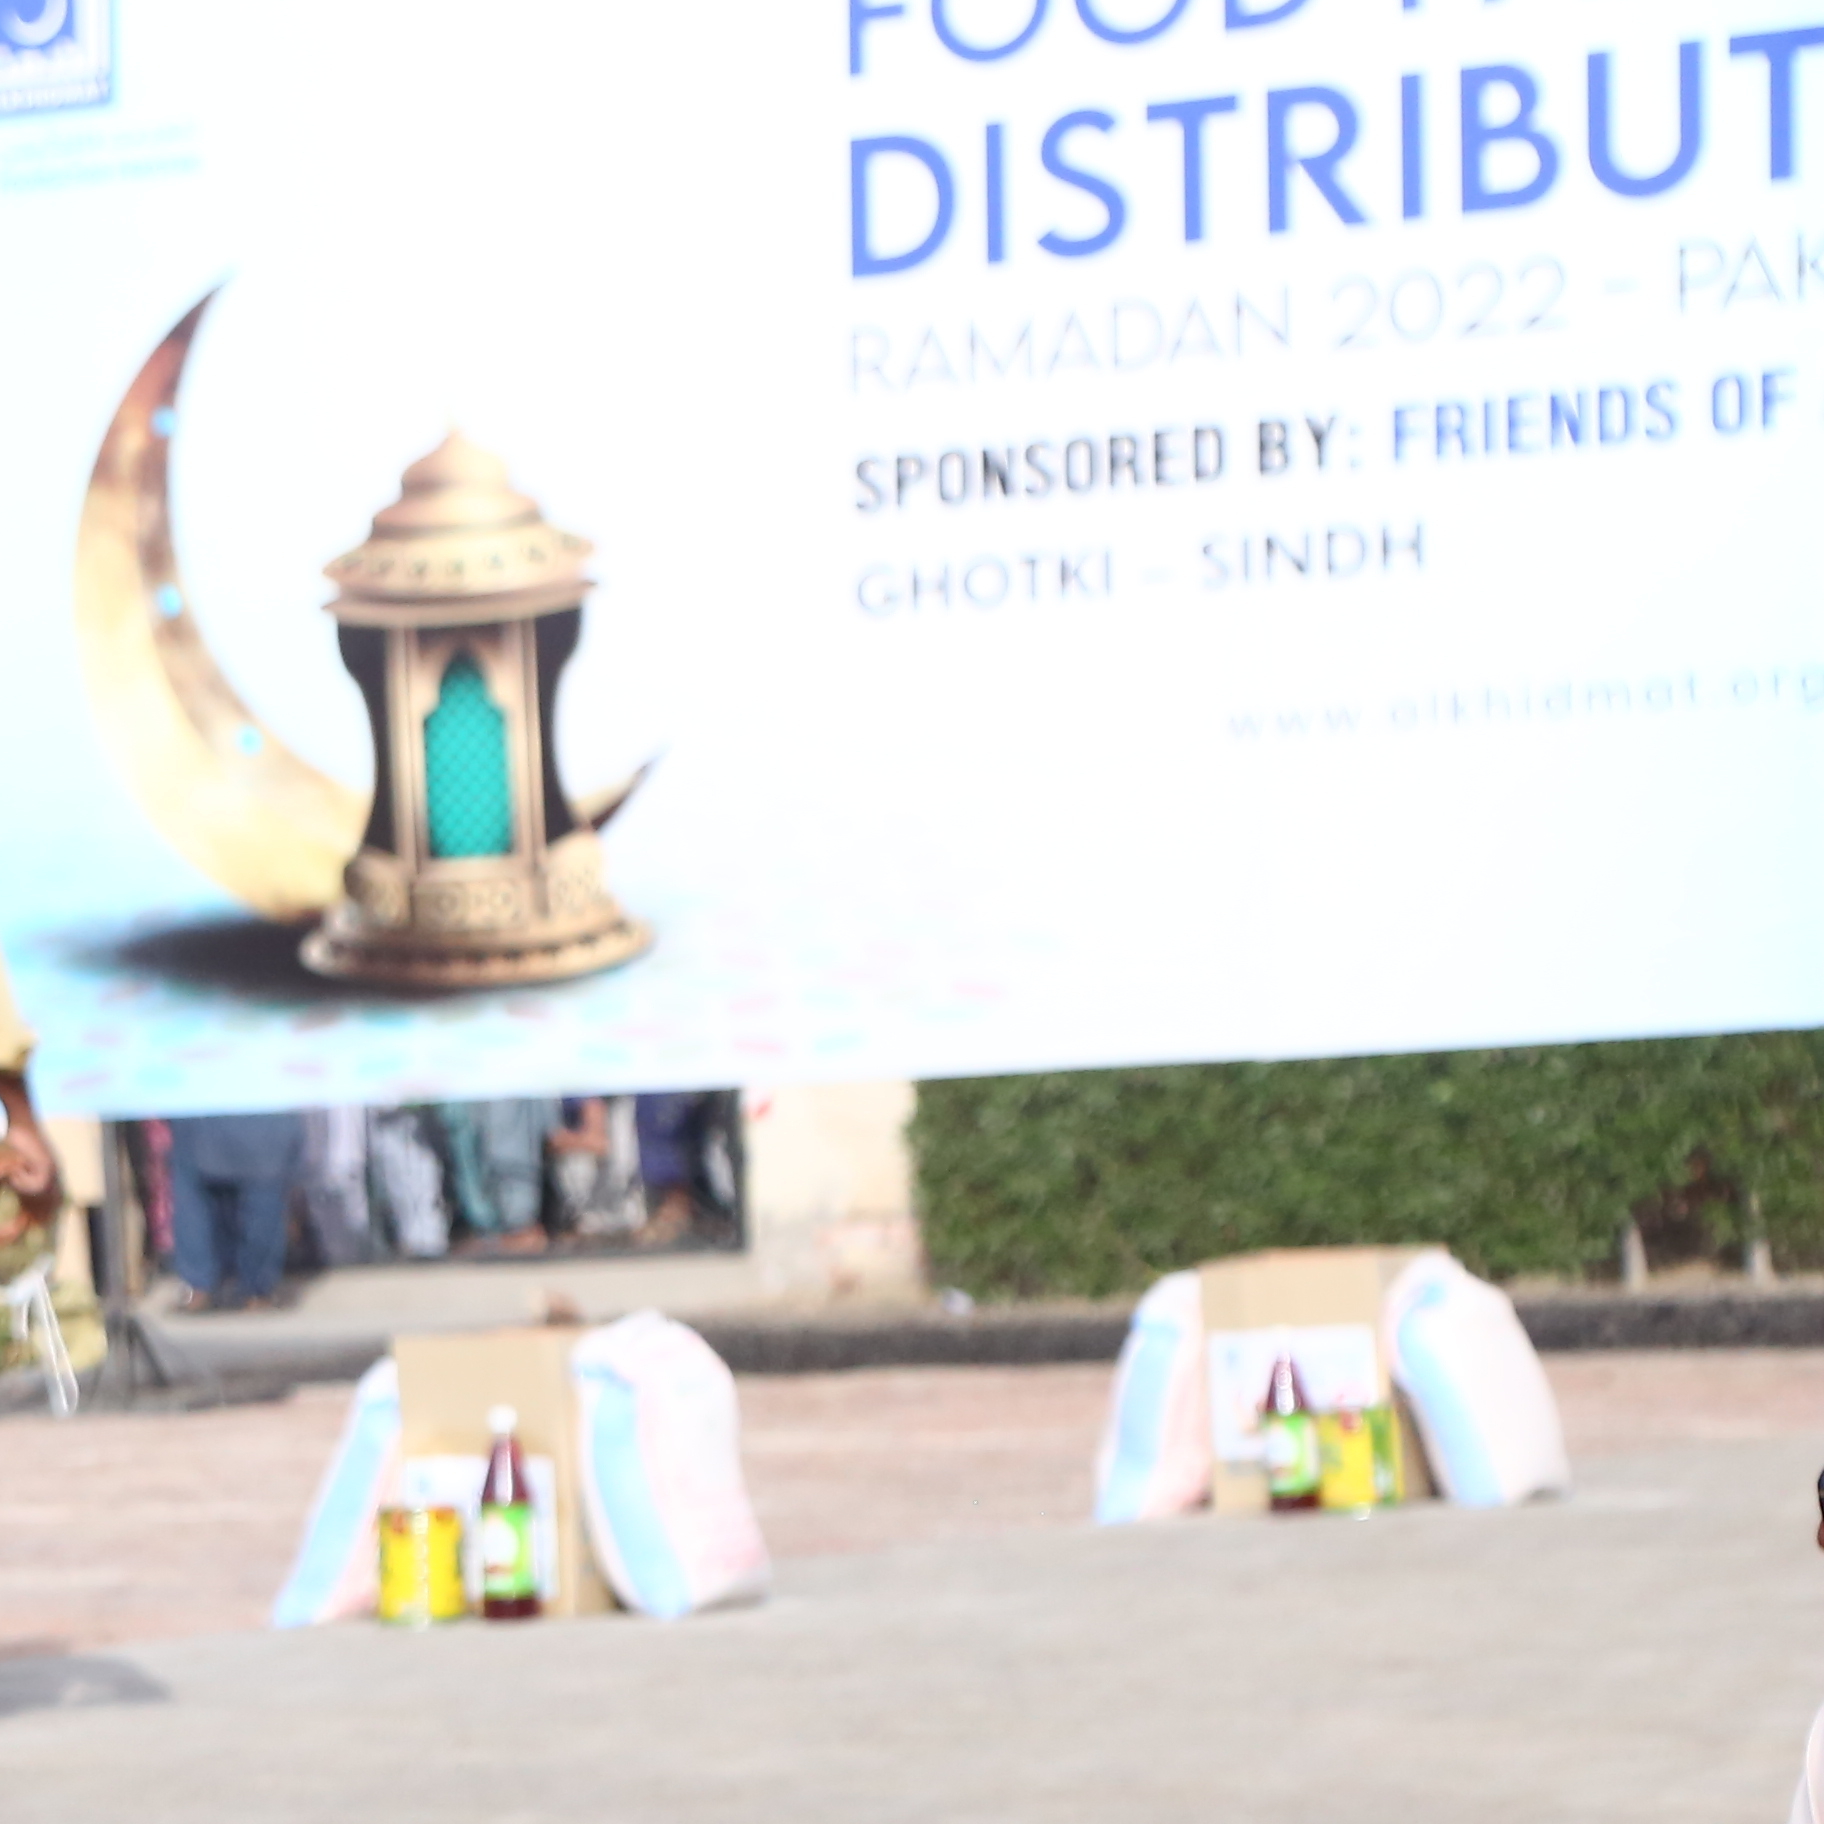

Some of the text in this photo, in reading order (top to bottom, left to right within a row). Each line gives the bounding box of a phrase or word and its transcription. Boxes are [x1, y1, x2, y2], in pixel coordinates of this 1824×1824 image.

[850, 26, 1824, 279] DISTRIBUT
[850, 286, 1291, 393] RAMADAN
[1332, 256, 1565, 351] 2022
[854, 368, 1797, 512] SPONSORED BY: FRIENDS OF
[855, 548, 1112, 618] GHOTKI
[1200, 522, 1425, 590] SINDH
